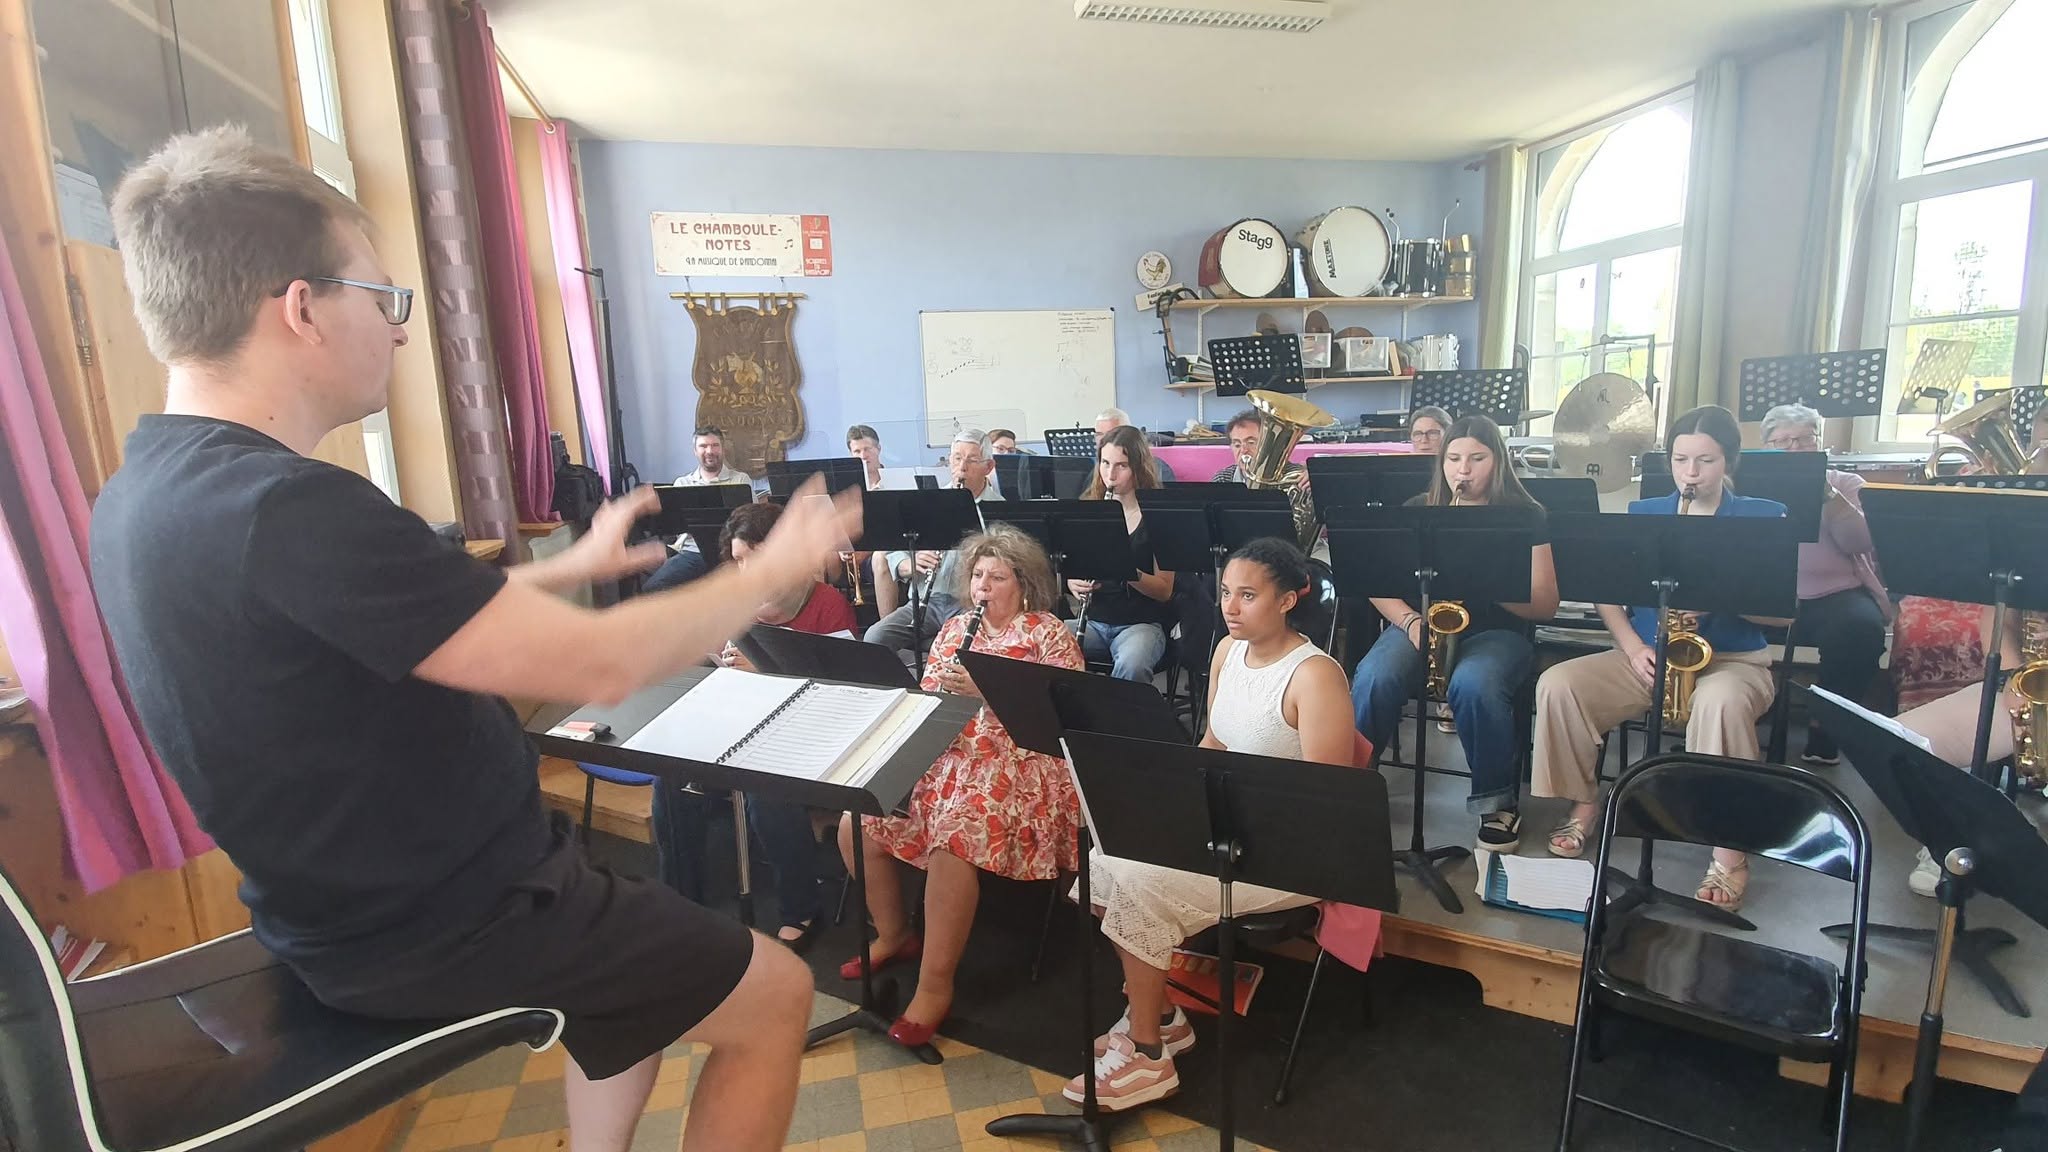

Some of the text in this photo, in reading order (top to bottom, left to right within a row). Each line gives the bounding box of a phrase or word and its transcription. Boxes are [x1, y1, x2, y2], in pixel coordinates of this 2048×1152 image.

[670, 222, 782, 236] LE CHAMBOULE-
[705, 239, 751, 251] NOTES
[1238, 229, 1273, 250] Stagg
[728, 257, 738, 266] DE
